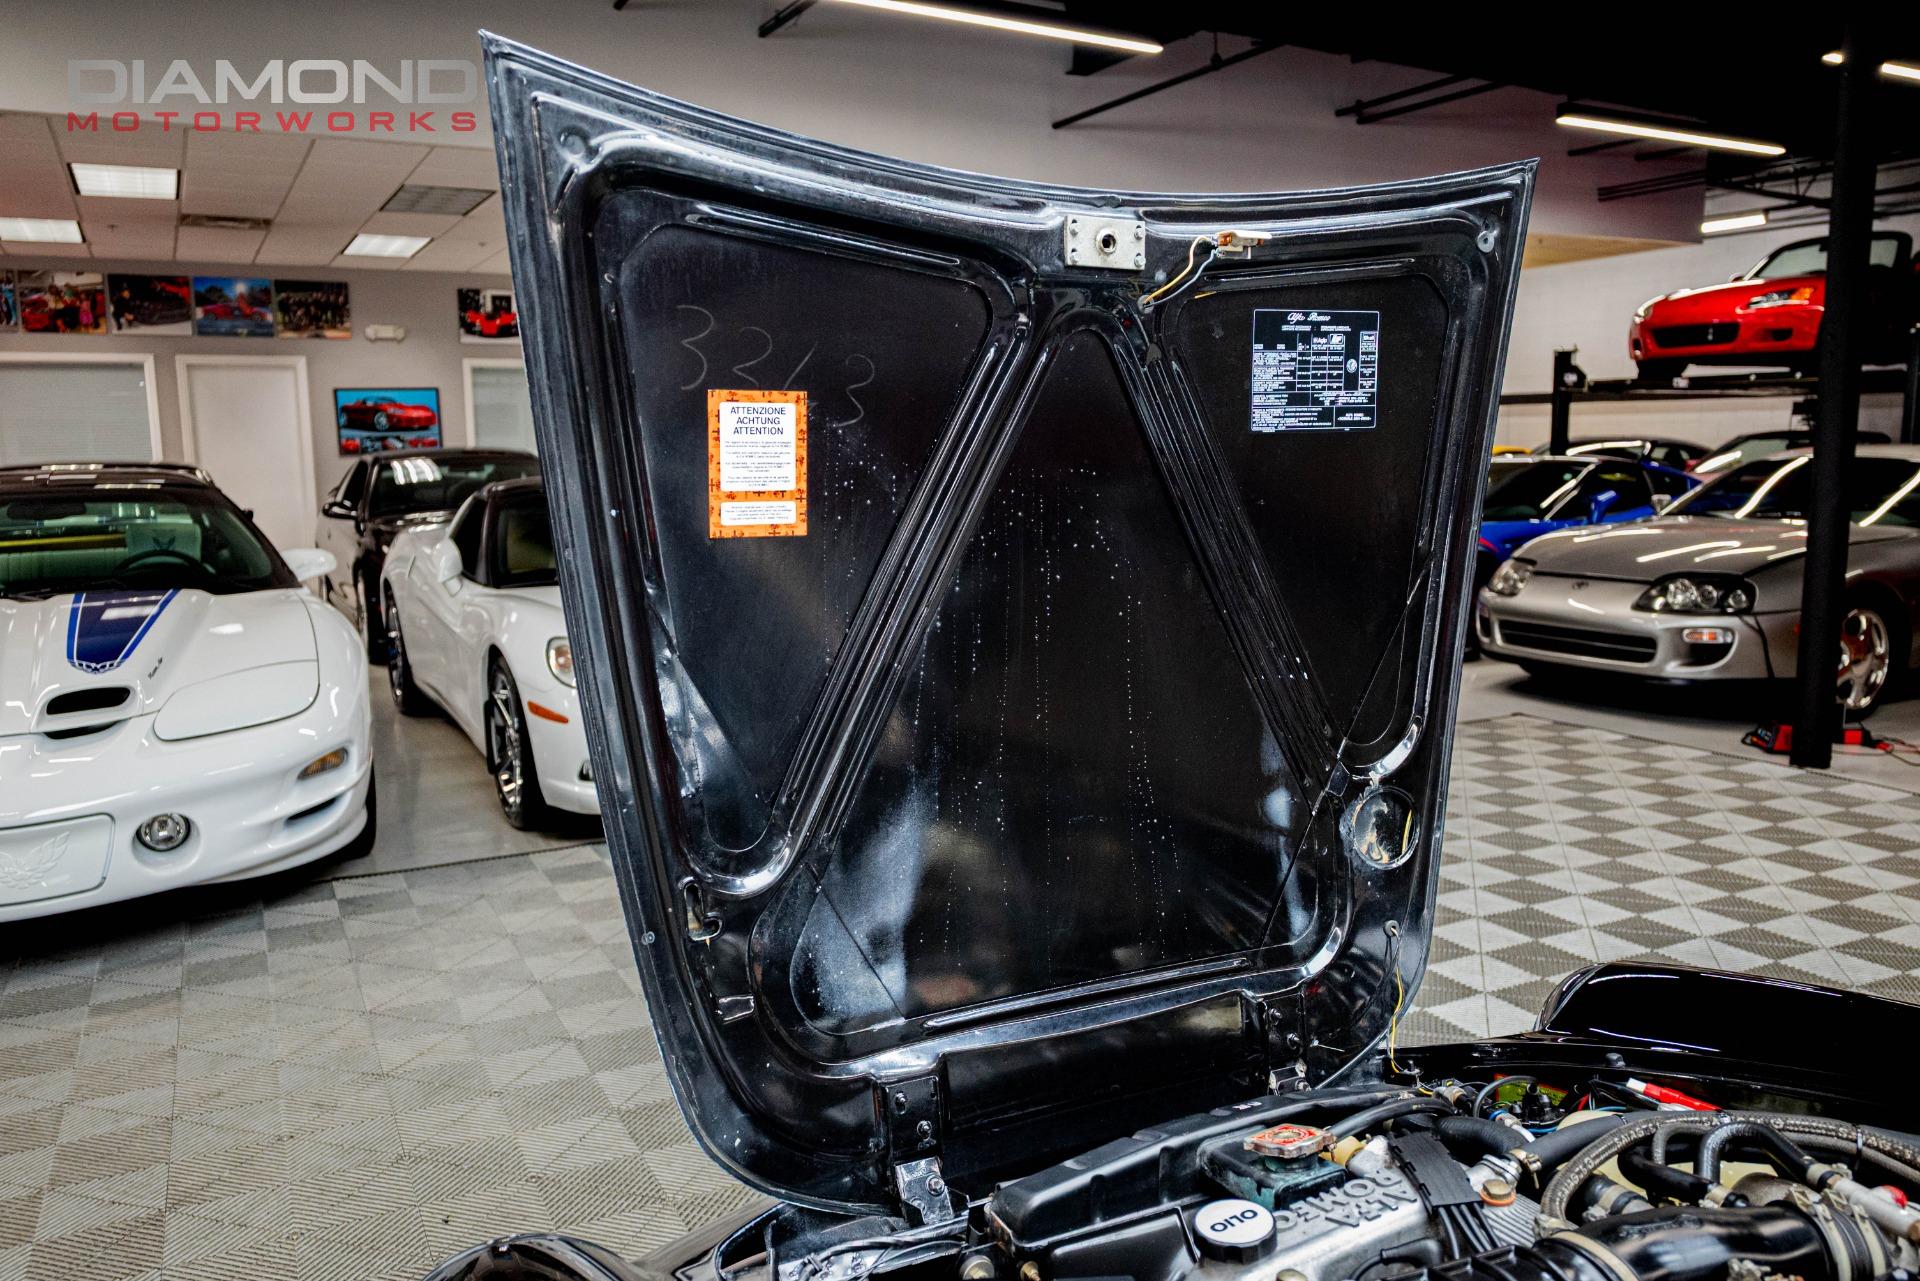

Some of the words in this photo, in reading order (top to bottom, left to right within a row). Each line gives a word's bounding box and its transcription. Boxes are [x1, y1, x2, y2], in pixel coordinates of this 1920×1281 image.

[1287, 312, 1306, 324] Alfa
[1307, 312, 1331, 322] Romeo
[730, 406, 786, 415] ATTENZIONE
[736, 416, 781, 425] ACHTUNG
[733, 426, 784, 435] ATTENTION
[1209, 1209, 1258, 1233] OLIO
